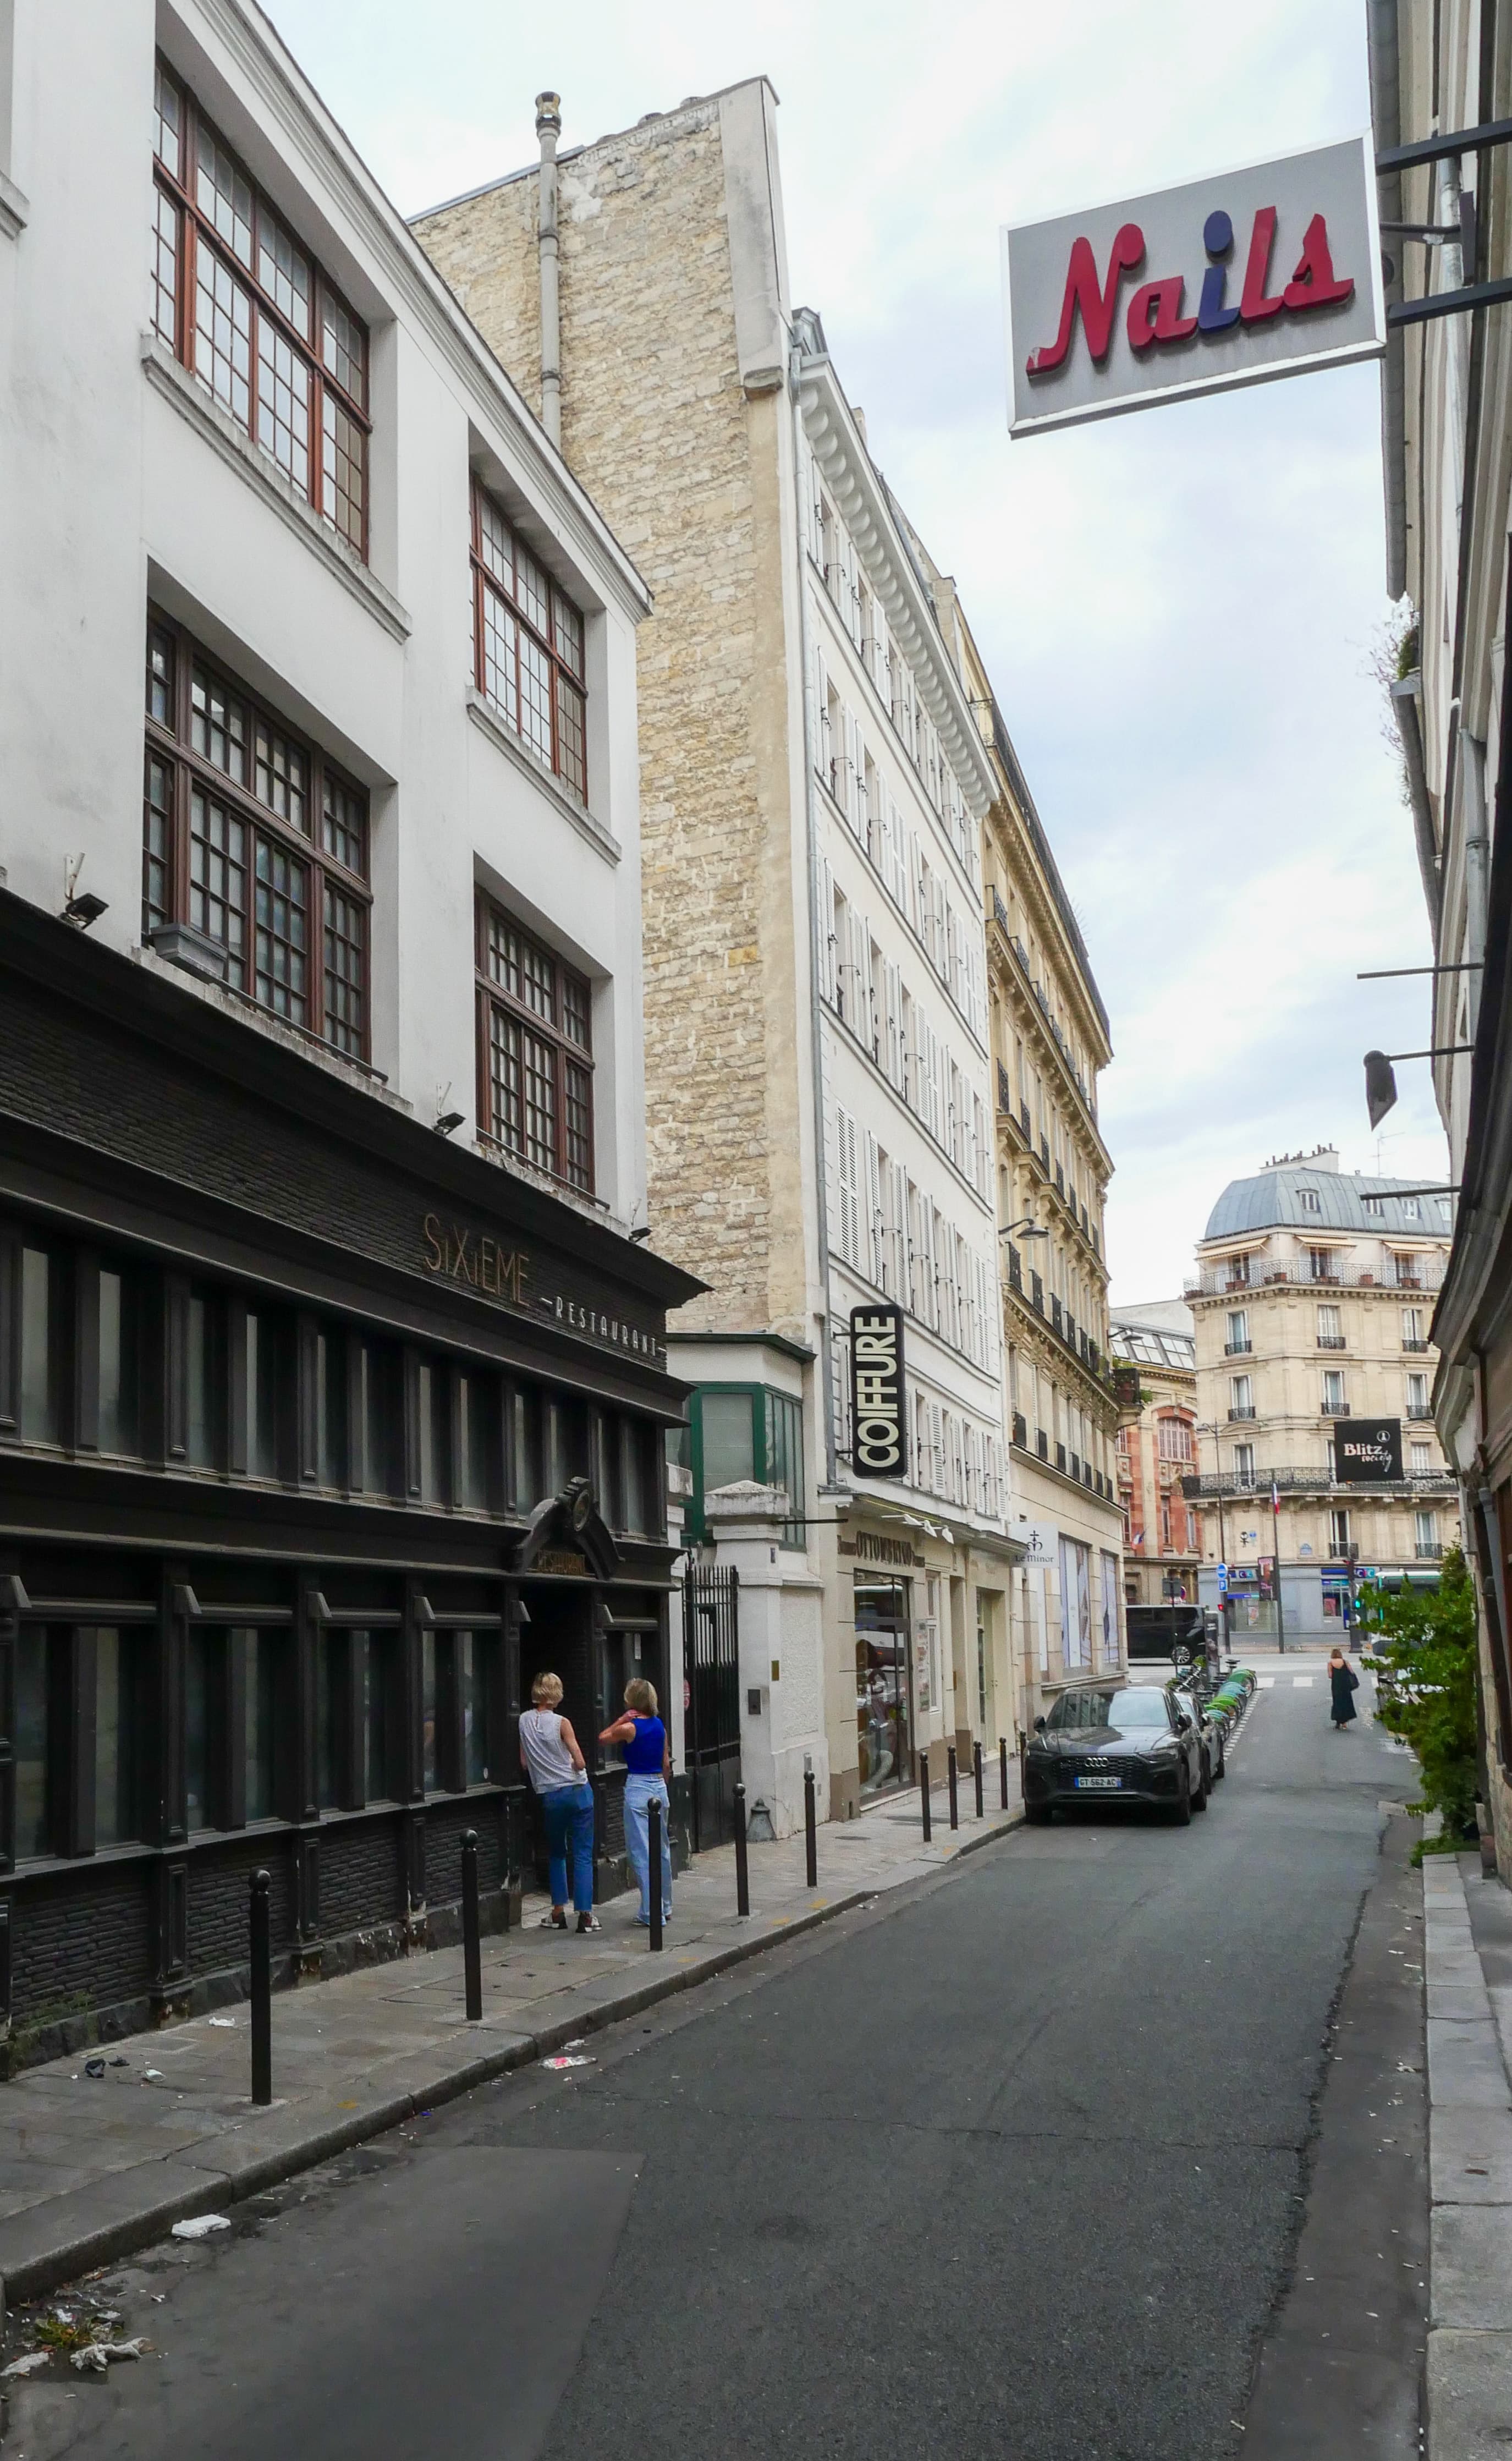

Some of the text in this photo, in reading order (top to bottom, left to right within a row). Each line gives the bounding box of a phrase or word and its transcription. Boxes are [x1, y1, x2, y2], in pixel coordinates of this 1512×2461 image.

[1026, 206, 1354, 376] Nails
[855, 1317, 900, 1468] COIFFURE
[1344, 1443, 1382, 1456] Blitz
